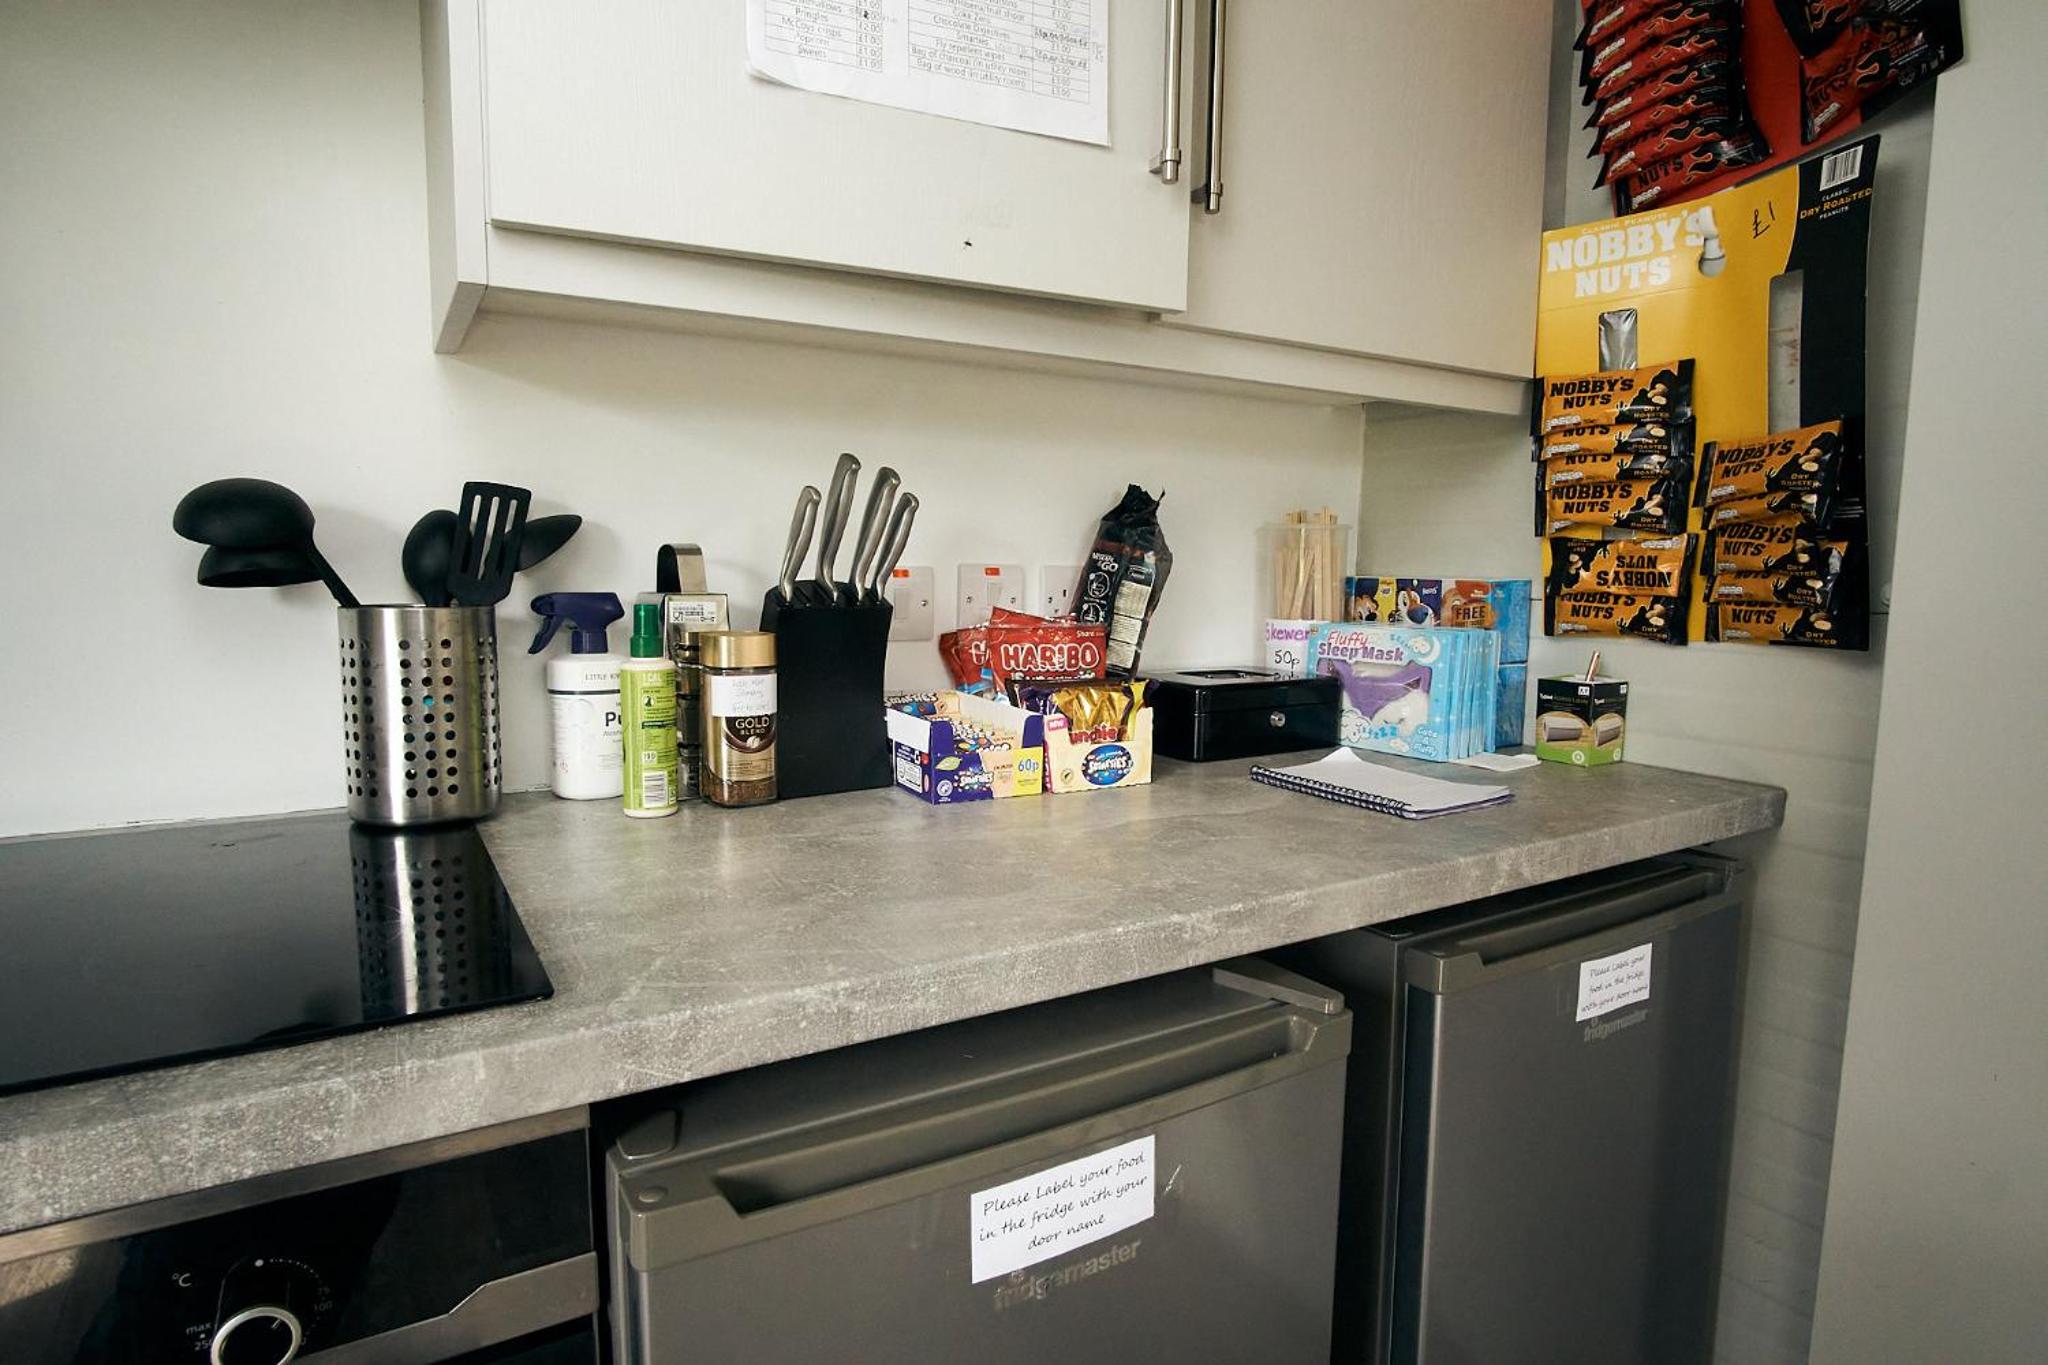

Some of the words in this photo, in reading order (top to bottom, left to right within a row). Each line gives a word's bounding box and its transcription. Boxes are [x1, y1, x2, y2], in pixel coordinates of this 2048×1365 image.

[1799, 207, 1821, 219] DRY
[1822, 187, 1873, 212] ROASTED
[1575, 256, 1672, 299] NUTS
[1550, 376, 1635, 398] NOBBY'S
[1562, 393, 1613, 410] NUTS
[1562, 425, 1611, 438] NUTS
[1564, 453, 1613, 465] NUTS
[1715, 438, 1796, 464] NOBBY'S
[1721, 459, 1766, 479] NUTS
[1552, 482, 1633, 501] NOBBY'S
[1562, 500, 1611, 515] NUTS
[1722, 540, 1767, 556] NUTS
[1615, 554, 1659, 569] NUTS
[1596, 570, 1673, 589] NOBBY'S
[1455, 605, 1487, 621] FREE
[1570, 604, 1615, 619] NUTS
[1731, 607, 1777, 625] NUTS
[1327, 631, 1370, 648] Fluffy
[1000, 642, 1100, 672] HARIBO
[1274, 649, 1300, 670] 50p
[1360, 647, 1405, 662] Mask
[735, 716, 770, 729] GOLD
[740, 728, 766, 736] BLEND
[1017, 757, 1040, 775] 60p
[983, 1192, 1031, 1217] Please
[1036, 1175, 1074, 1200] Label
[1079, 1164, 1113, 1187] your
[1115, 1151, 1146, 1177] food
[978, 1228, 996, 1243] in
[1000, 1216, 1026, 1235] the
[1029, 1202, 1075, 1230] fridge
[1079, 1186, 1113, 1209] with
[1115, 1174, 1149, 1199] your
[1027, 1231, 1062, 1251] door
[1066, 1213, 1106, 1237] name
[171, 1272, 193, 1288] °C
[185, 1322, 213, 1335] max
